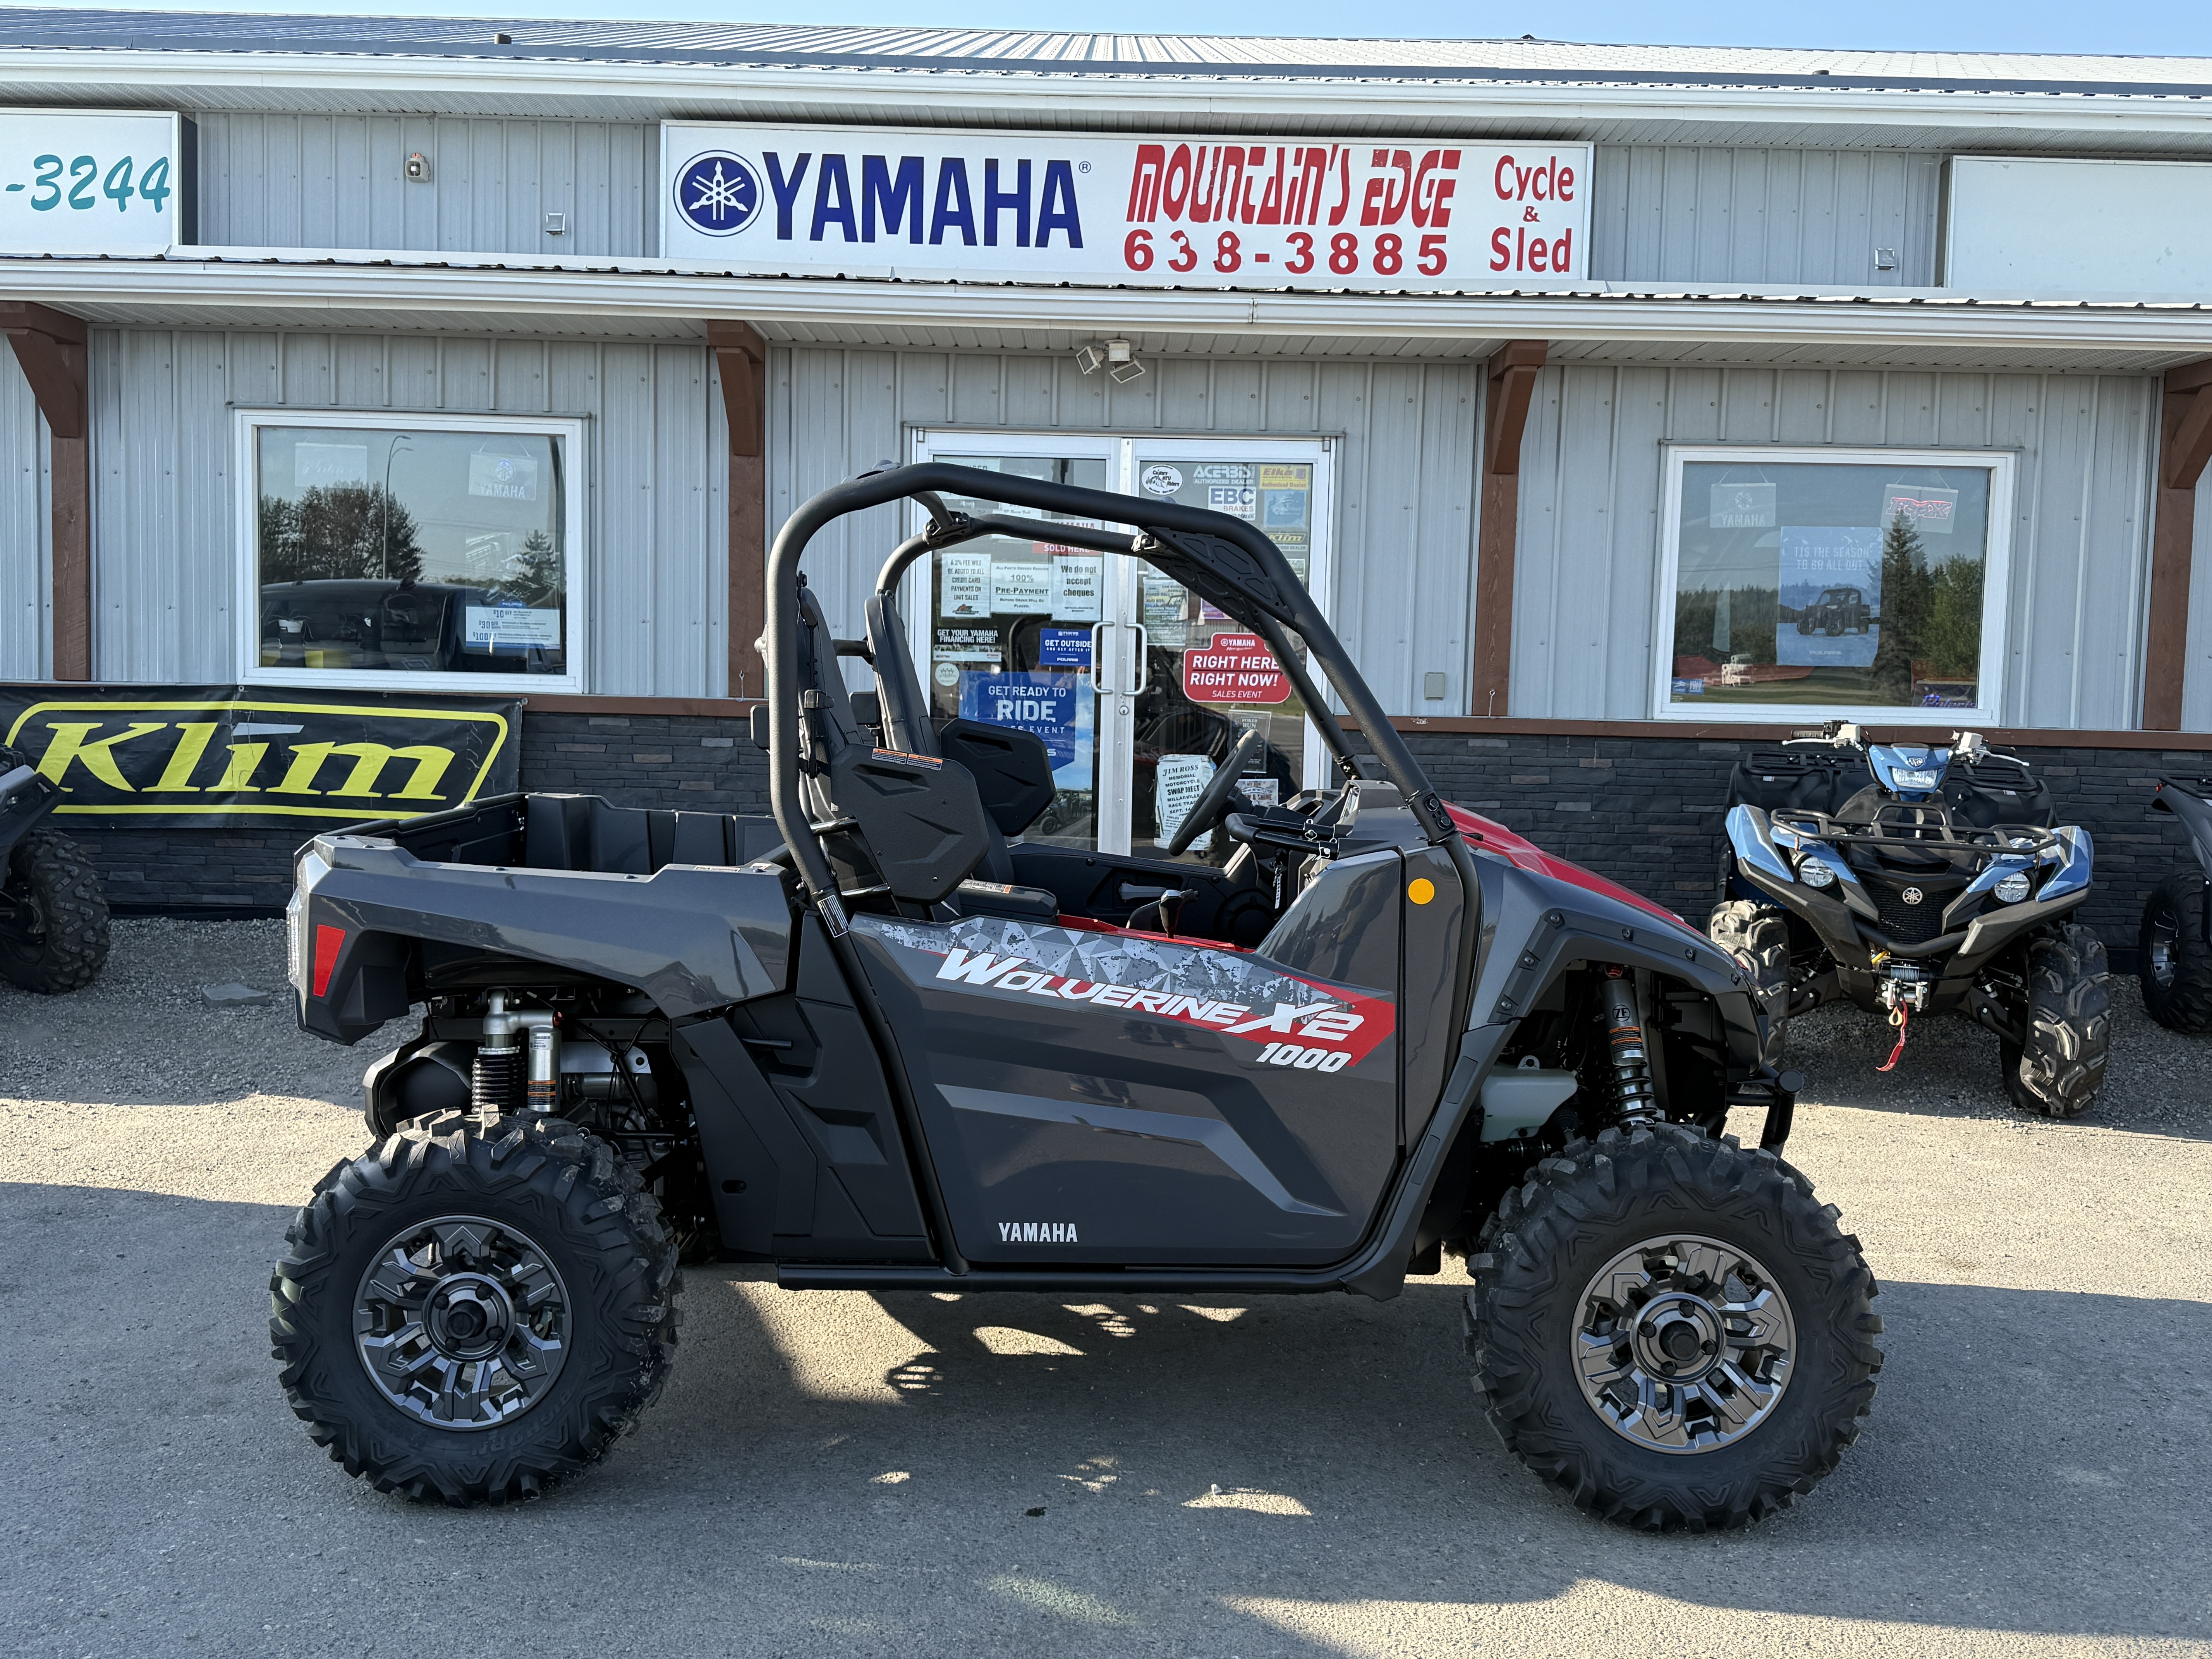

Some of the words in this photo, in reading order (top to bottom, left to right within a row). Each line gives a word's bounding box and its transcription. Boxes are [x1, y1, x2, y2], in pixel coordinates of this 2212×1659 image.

[1494, 155, 1574, 202] Cycle
[1360, 149, 1462, 228] EDGE
[762, 151, 1083, 248] YAMAHA
[1523, 206, 1540, 222] &
[1124, 229, 1447, 275] 638-3885
[1490, 227, 1572, 273] Sled
[1193, 465, 1251, 478] ACERBIS
[479, 483, 525, 498] YAMAHA
[1211, 488, 1254, 505] EBC
[1721, 514, 1765, 526] YAMAHA
[1795, 547, 1810, 557] TIS
[1814, 547, 1831, 558] THE
[1834, 547, 1870, 558] SEASON
[1797, 560, 1808, 569] TO
[1812, 560, 1823, 570] GO
[1827, 560, 1843, 570] ALL
[1063, 589, 1094, 597] cheques
[493, 610, 504, 618] $10
[479, 620, 490, 629] $30
[473, 632, 488, 641] $100
[1193, 656, 1238, 668] RIGHT
[1240, 656, 1279, 670] HERE
[1190, 673, 1235, 686] RIGHT
[1238, 673, 1278, 687] NOW!
[988, 686, 1010, 696] GET
[1012, 687, 1049, 697] READY
[1052, 688, 1066, 697] TO
[997, 700, 1056, 723] RIDE
[1163, 768, 1178, 776] JIM
[1165, 779, 1200, 787] MOTORCYCLE
[1185, 785, 1199, 793] MEET
[1613, 1008, 1630, 1019] ZF
[1223, 1003, 1365, 1041] X2
[1256, 1043, 1352, 1072] 1000
[999, 1222, 1078, 1243] YAMAHA
